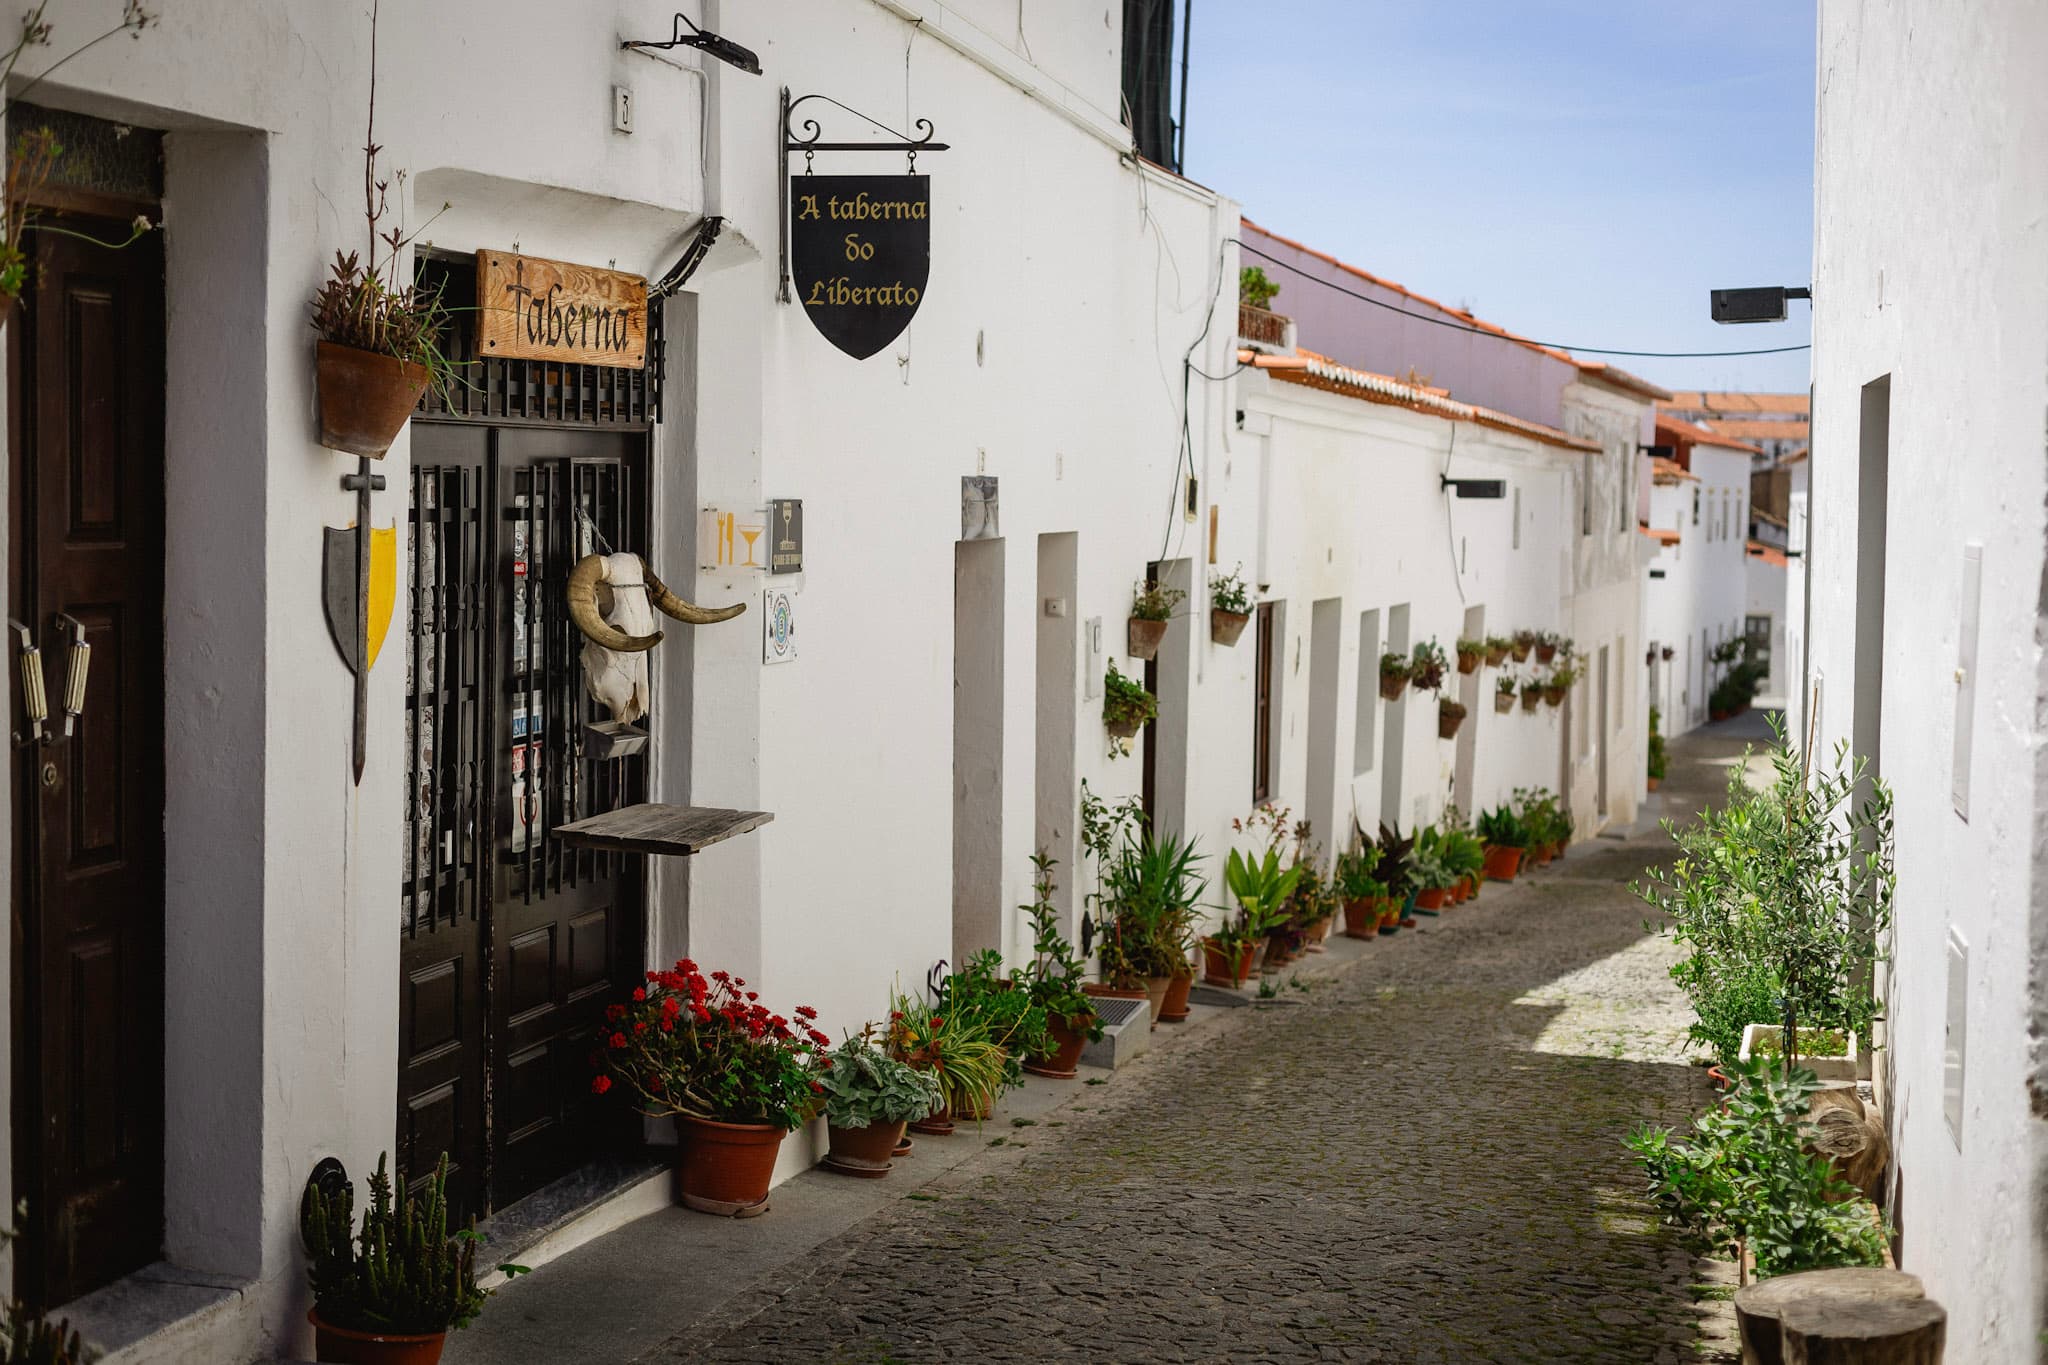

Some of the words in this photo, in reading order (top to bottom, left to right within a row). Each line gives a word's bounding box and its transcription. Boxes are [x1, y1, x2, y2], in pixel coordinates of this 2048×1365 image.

[622, 94, 629, 125] 3
[798, 194, 821, 220] A
[827, 192, 927, 220] taberna
[844, 233, 875, 262] do
[805, 276, 920, 306] Liberato
